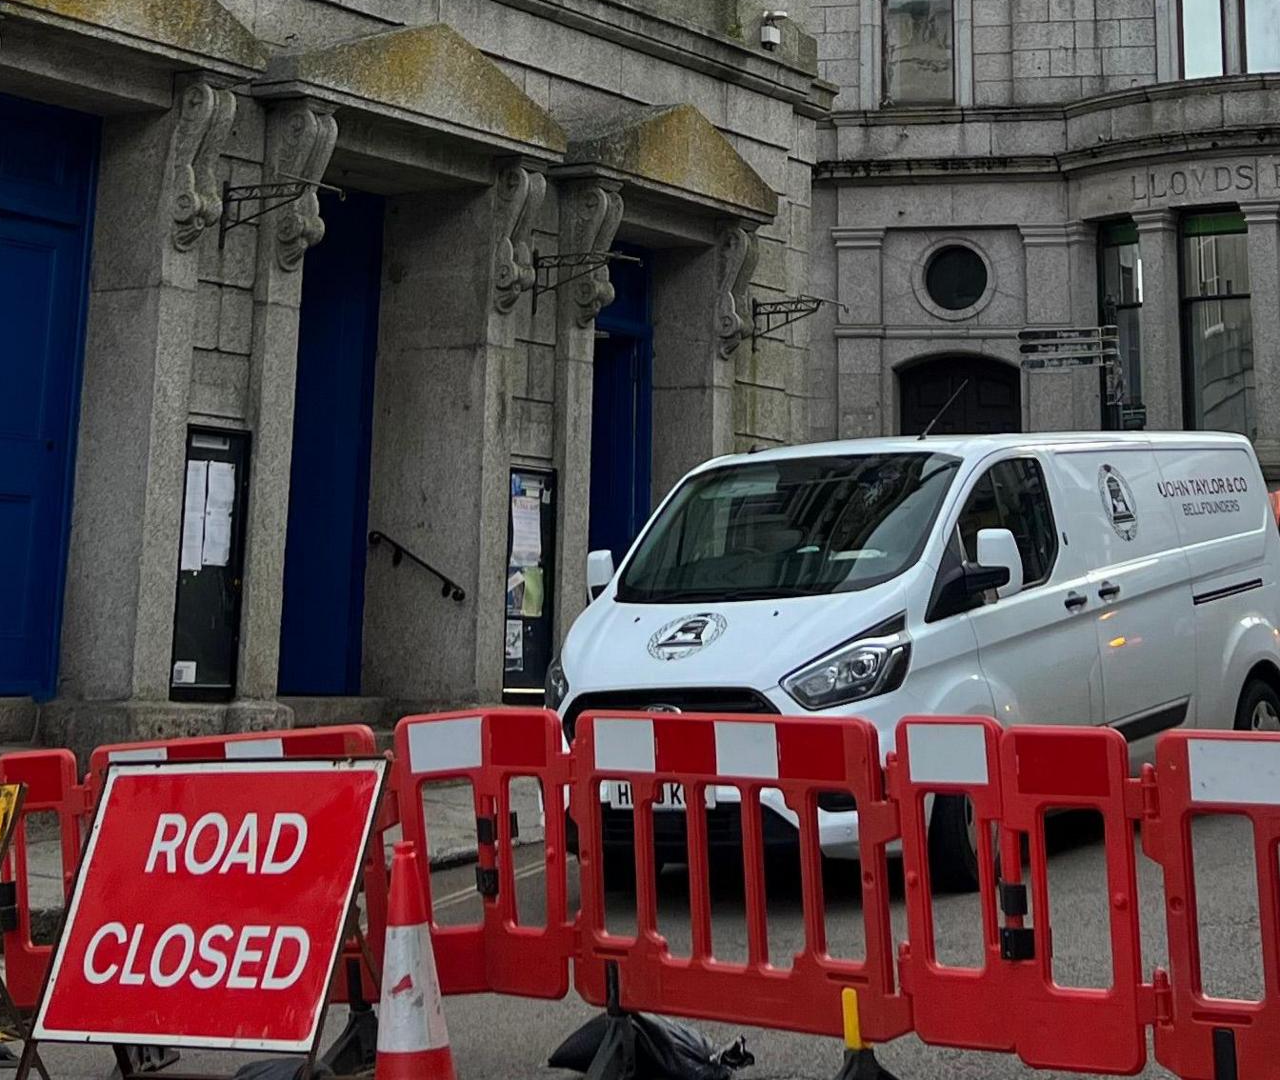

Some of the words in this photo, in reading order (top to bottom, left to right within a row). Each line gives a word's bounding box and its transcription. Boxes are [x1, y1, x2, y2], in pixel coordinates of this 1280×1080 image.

[1131, 165, 1255, 201] LLOYDS
[1157, 481, 1189, 498] JOHN
[1189, 478, 1226, 497] TAYLOR
[1234, 476, 1248, 492] CO
[1183, 500, 1240, 515] BELLFOUNDERS
[146, 812, 308, 875] ROAD
[83, 923, 310, 990] CLOSED
